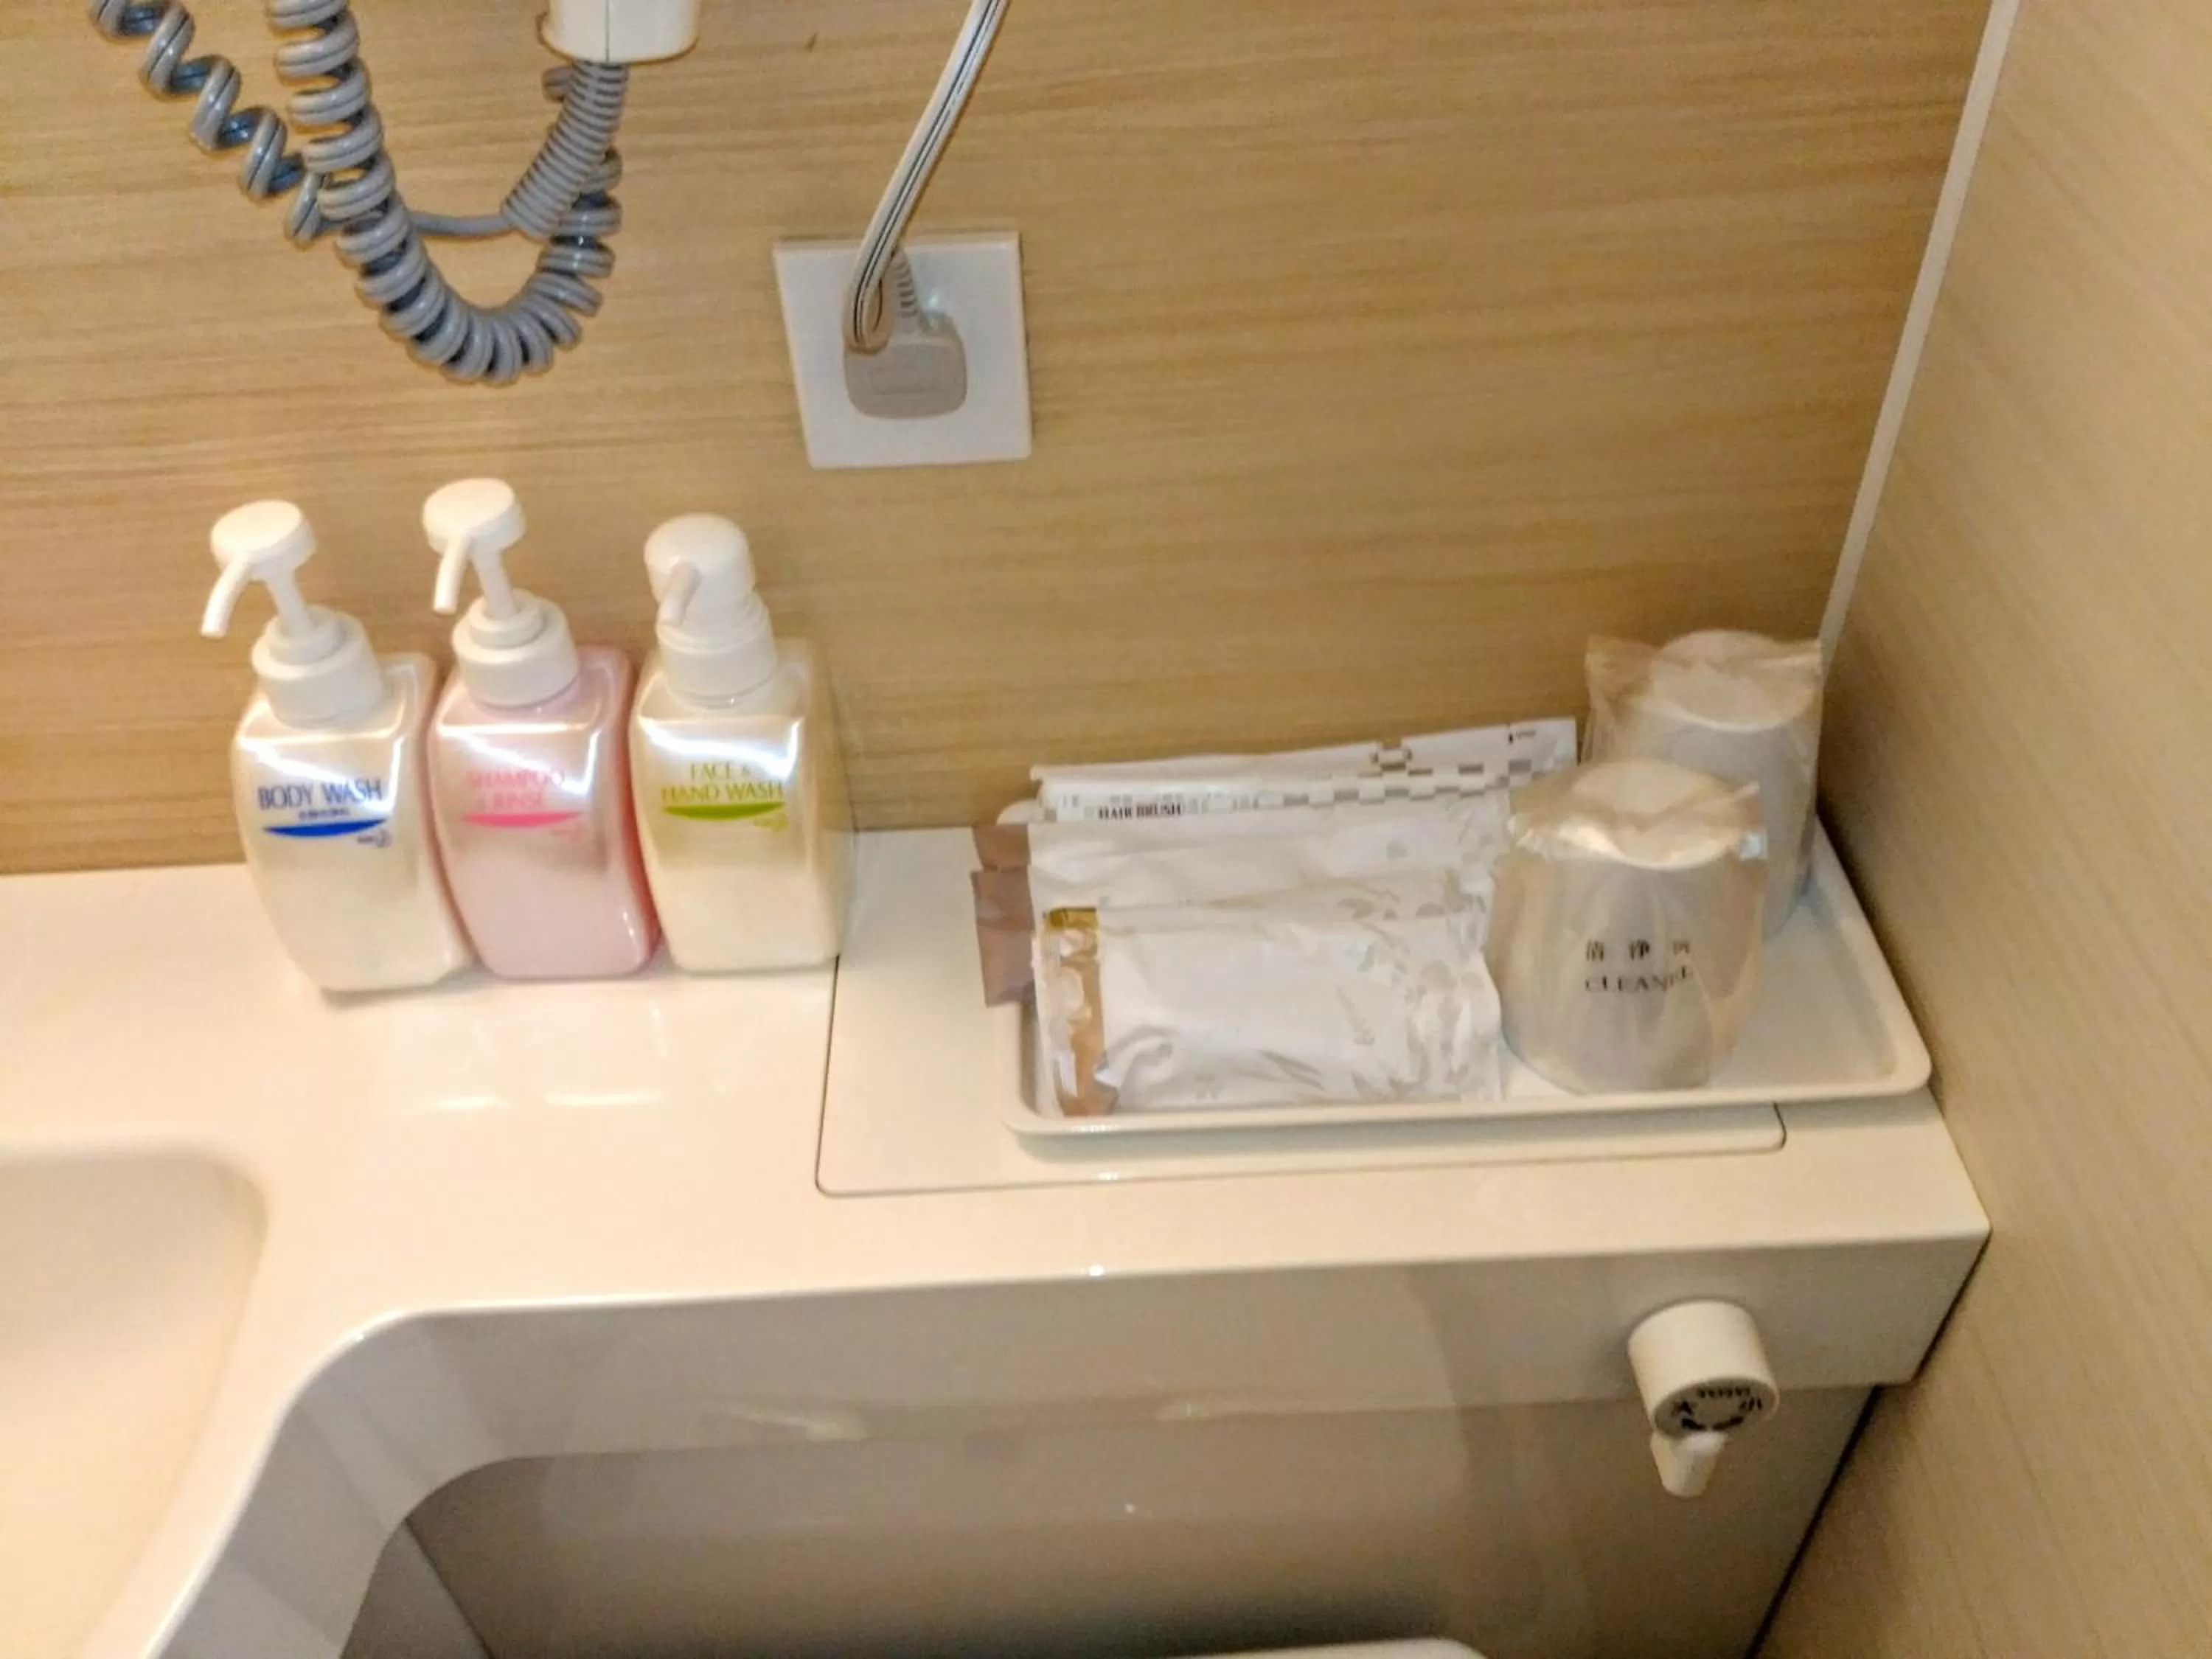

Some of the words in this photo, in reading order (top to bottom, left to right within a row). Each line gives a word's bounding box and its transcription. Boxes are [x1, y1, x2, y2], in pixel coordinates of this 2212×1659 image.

[258, 782, 313, 809] BODY
[321, 777, 383, 804] WASH
[661, 784, 720, 801] HAND
[726, 779, 785, 800] WASH
[1099, 805, 1133, 821] HAIR
[1136, 801, 1182, 819] BRUSH
